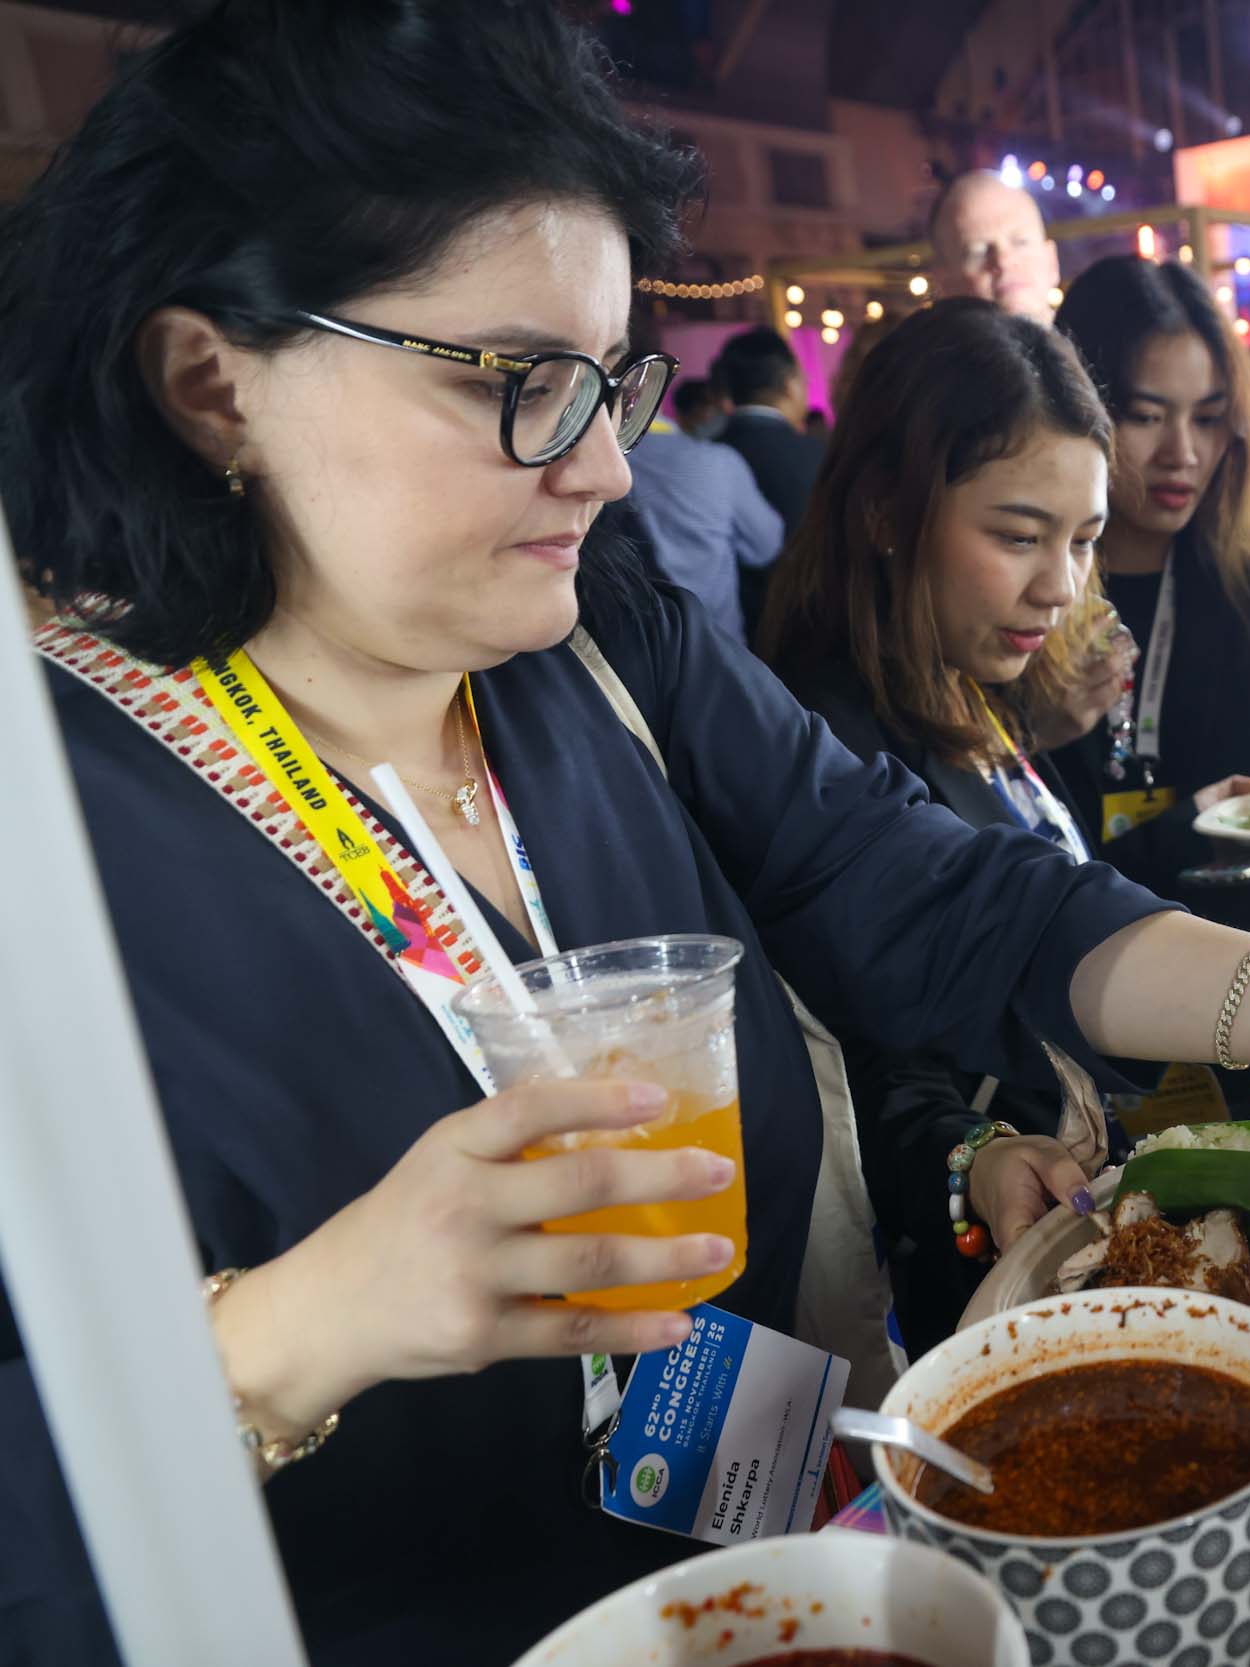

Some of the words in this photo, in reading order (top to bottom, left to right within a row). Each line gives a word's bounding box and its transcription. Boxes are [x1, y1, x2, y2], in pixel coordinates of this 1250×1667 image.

[211, 662, 263, 726] NGKOK,
[259, 726, 328, 812] THAILAND
[659, 1316, 706, 1442] CONGRESS
[685, 1347, 710, 1413] NOVEMBER
[700, 1404, 719, 1441] Starts
[651, 1468, 665, 1498] ICCA
[712, 1461, 741, 1530] Elenida
[730, 1459, 760, 1535] Shkarpa
